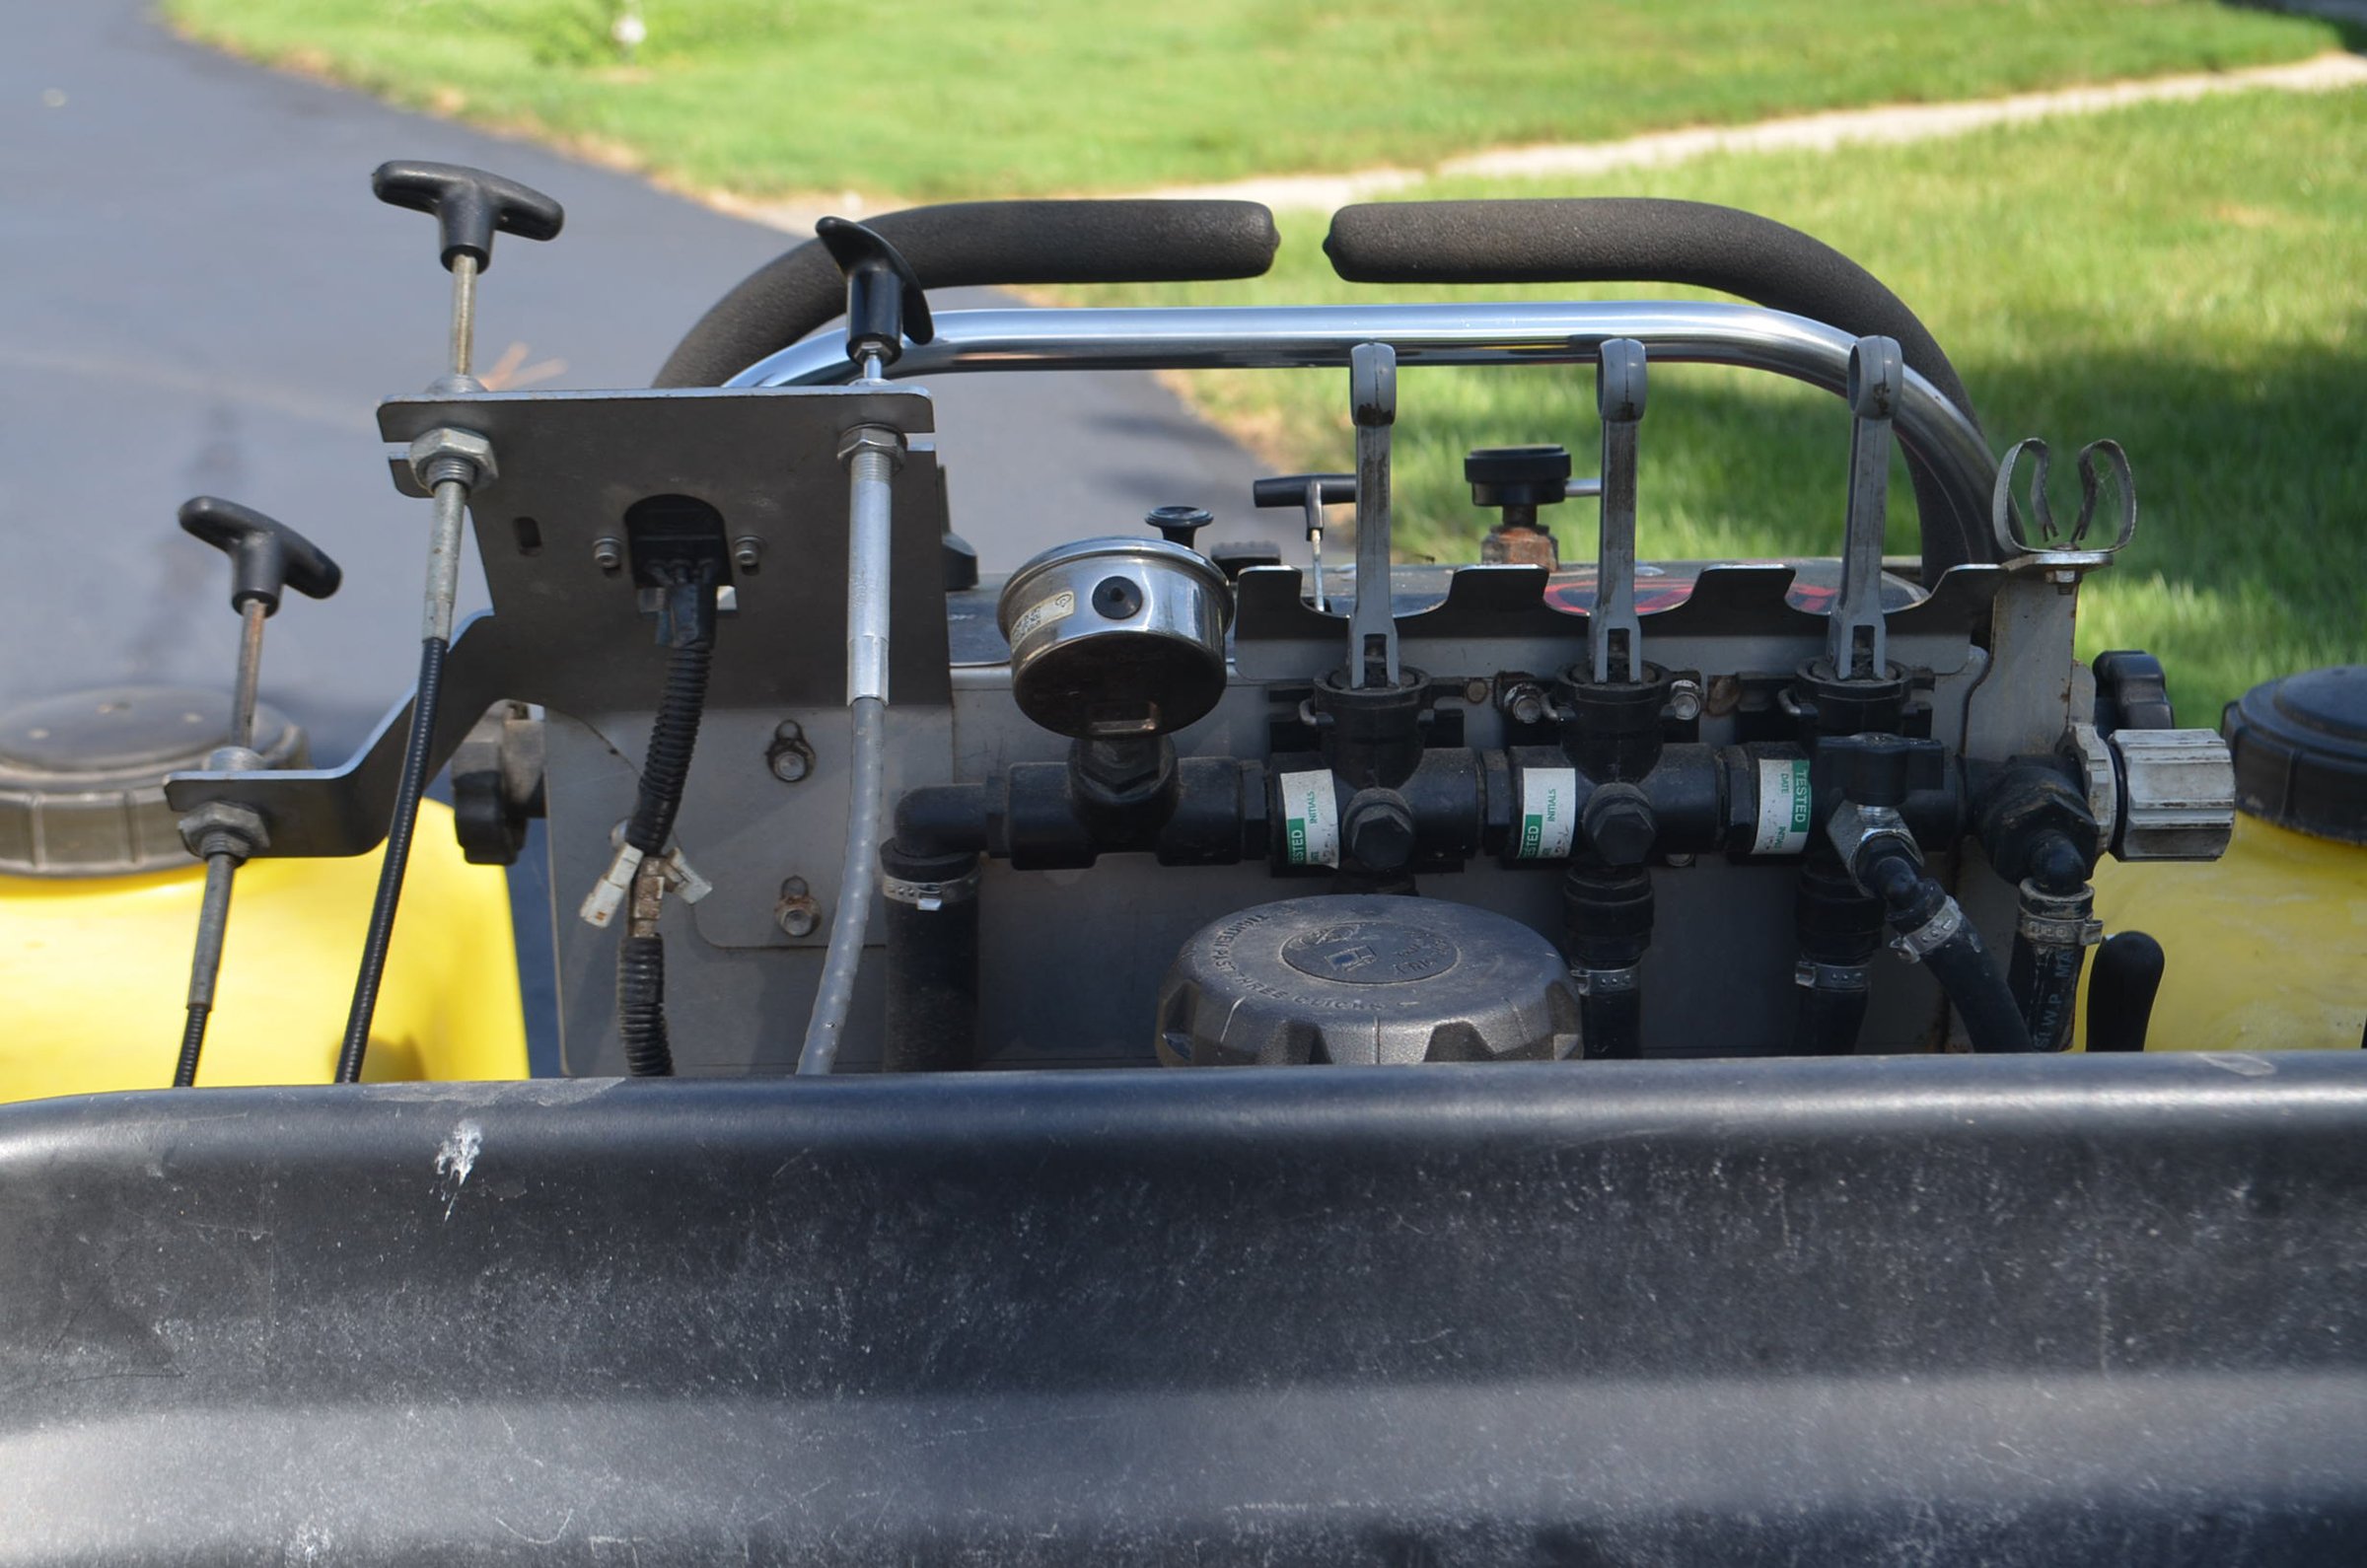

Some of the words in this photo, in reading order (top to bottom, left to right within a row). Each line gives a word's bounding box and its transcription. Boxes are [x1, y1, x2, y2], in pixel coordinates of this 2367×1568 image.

[1780, 772, 1790, 795] DATE
[1795, 769, 1808, 823] TESTED
[1306, 790, 1319, 825] INITIALS
[1545, 788, 1557, 822] INITIALS
[1291, 829, 1304, 862] ESTED
[1211, 948, 1237, 971] PAST
[1232, 970, 1289, 999] THREE
[1293, 995, 1385, 1011] CLICKS
[2034, 1032, 2050, 1049] SI
[2054, 951, 2074, 978] MA
